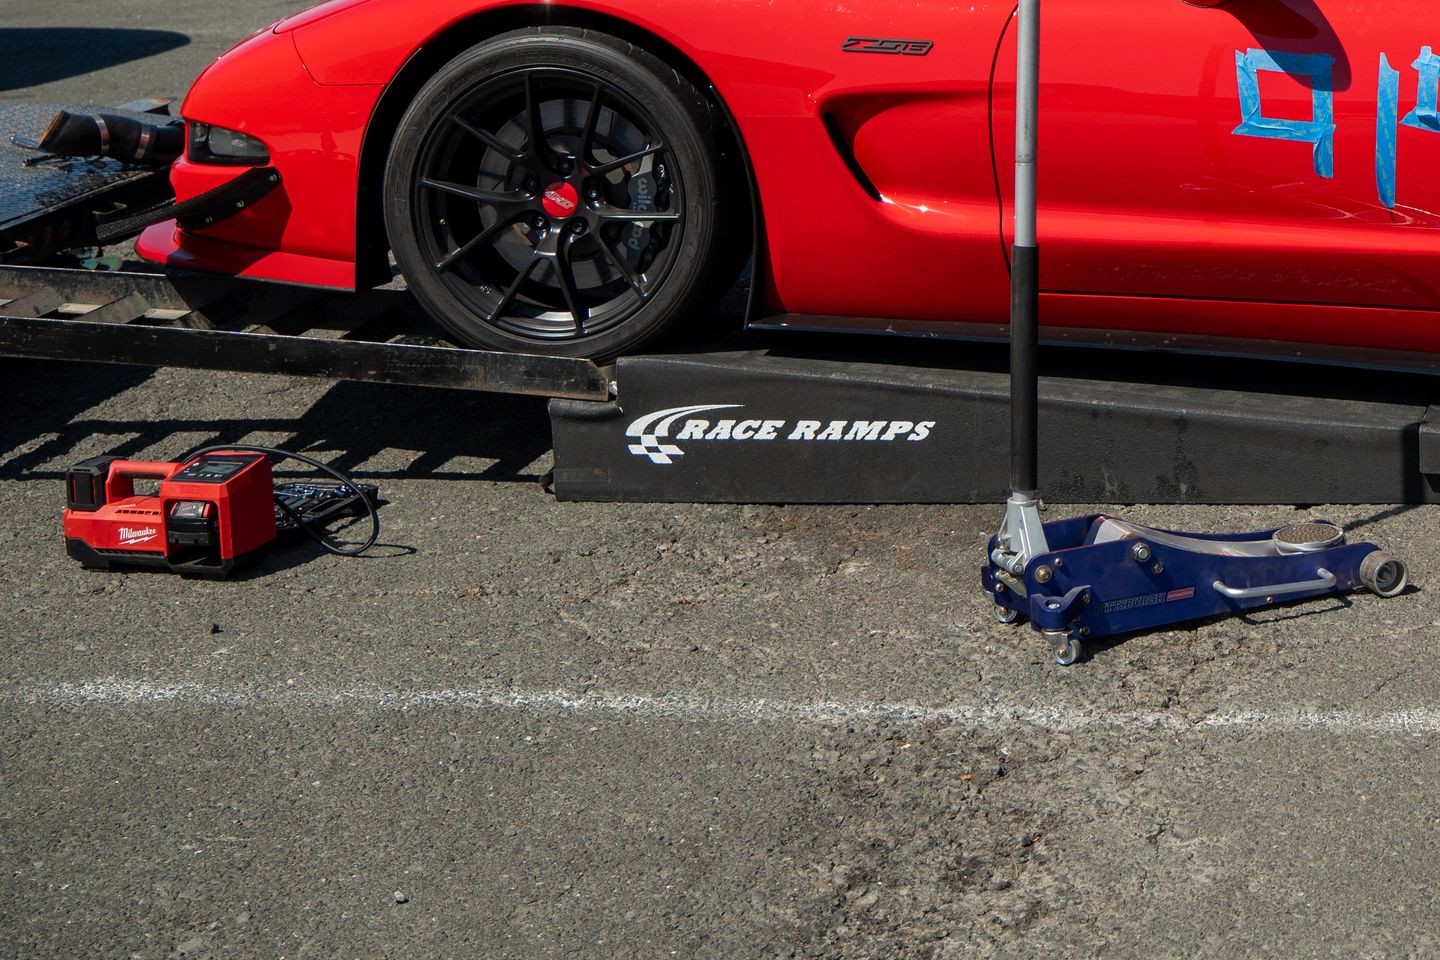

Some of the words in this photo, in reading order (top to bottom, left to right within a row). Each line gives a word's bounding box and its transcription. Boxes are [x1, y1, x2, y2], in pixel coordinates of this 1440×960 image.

[841, 36, 934, 56] Z06
[676, 420, 786, 440] RACE
[788, 420, 936, 441] RAMPS
[118, 526, 157, 541] Milwaukee
